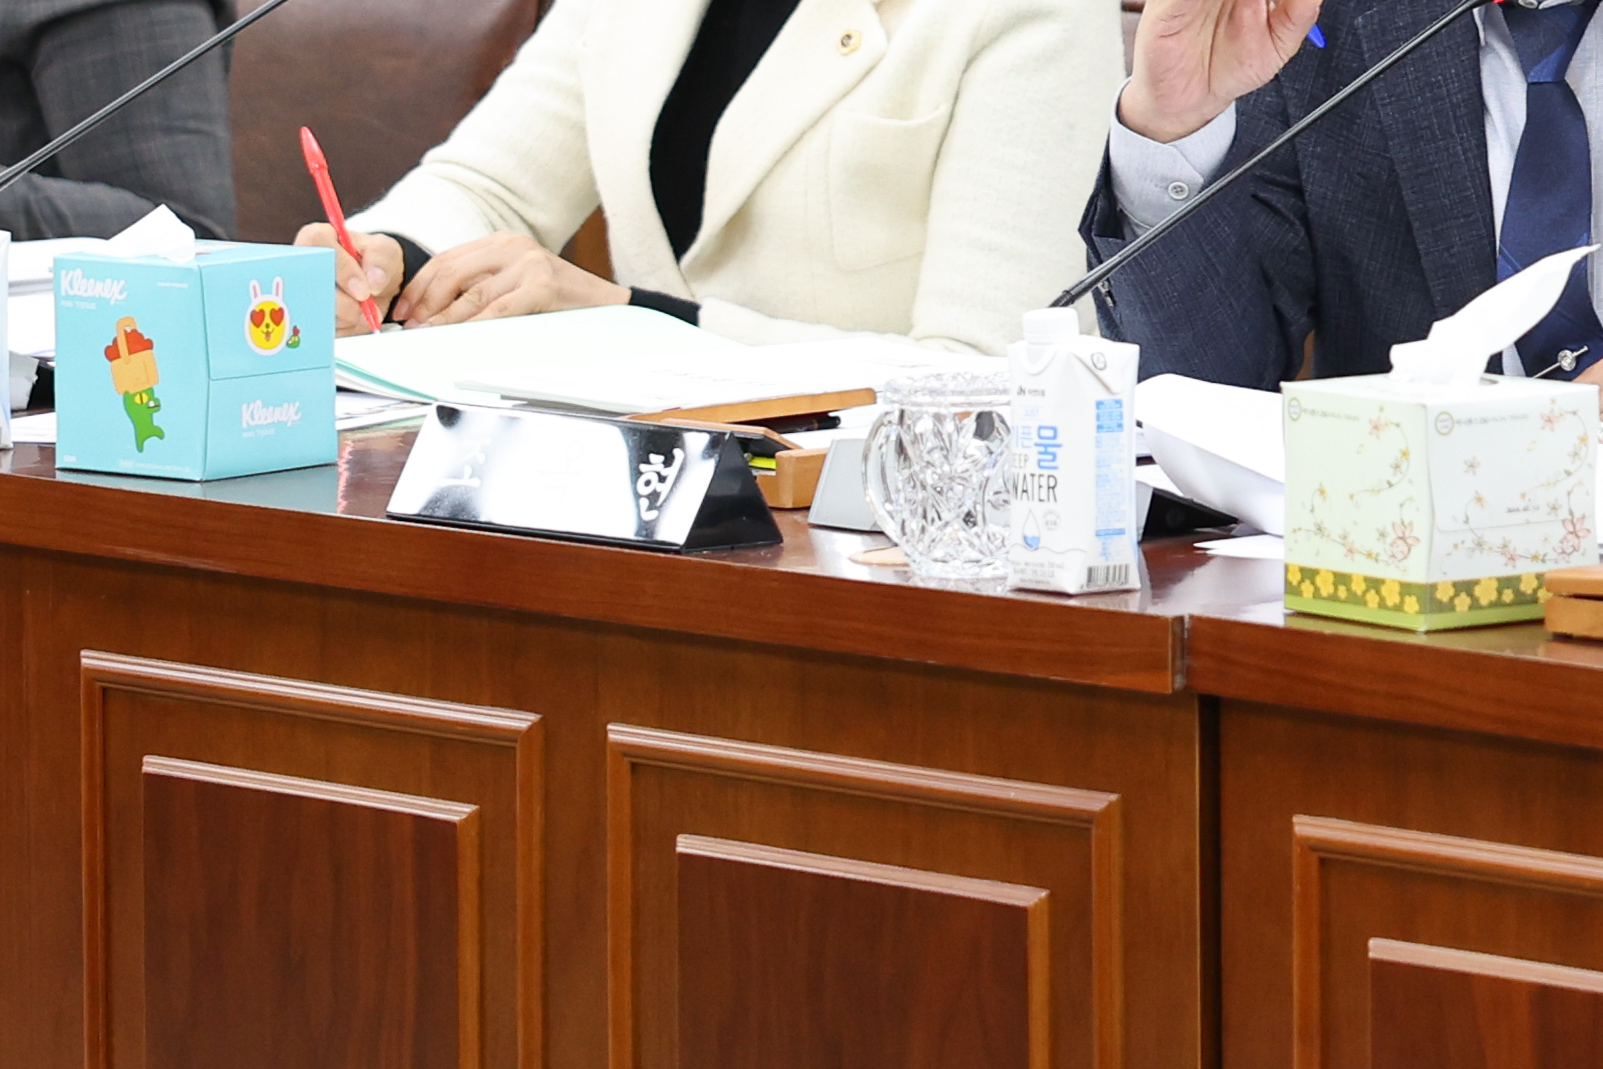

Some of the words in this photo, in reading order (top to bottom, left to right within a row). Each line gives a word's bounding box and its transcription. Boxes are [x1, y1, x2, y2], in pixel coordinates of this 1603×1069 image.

[60, 268, 127, 305] Kleenex
[241, 399, 302, 428] Kleenex
[1034, 425, 1063, 470] 물
